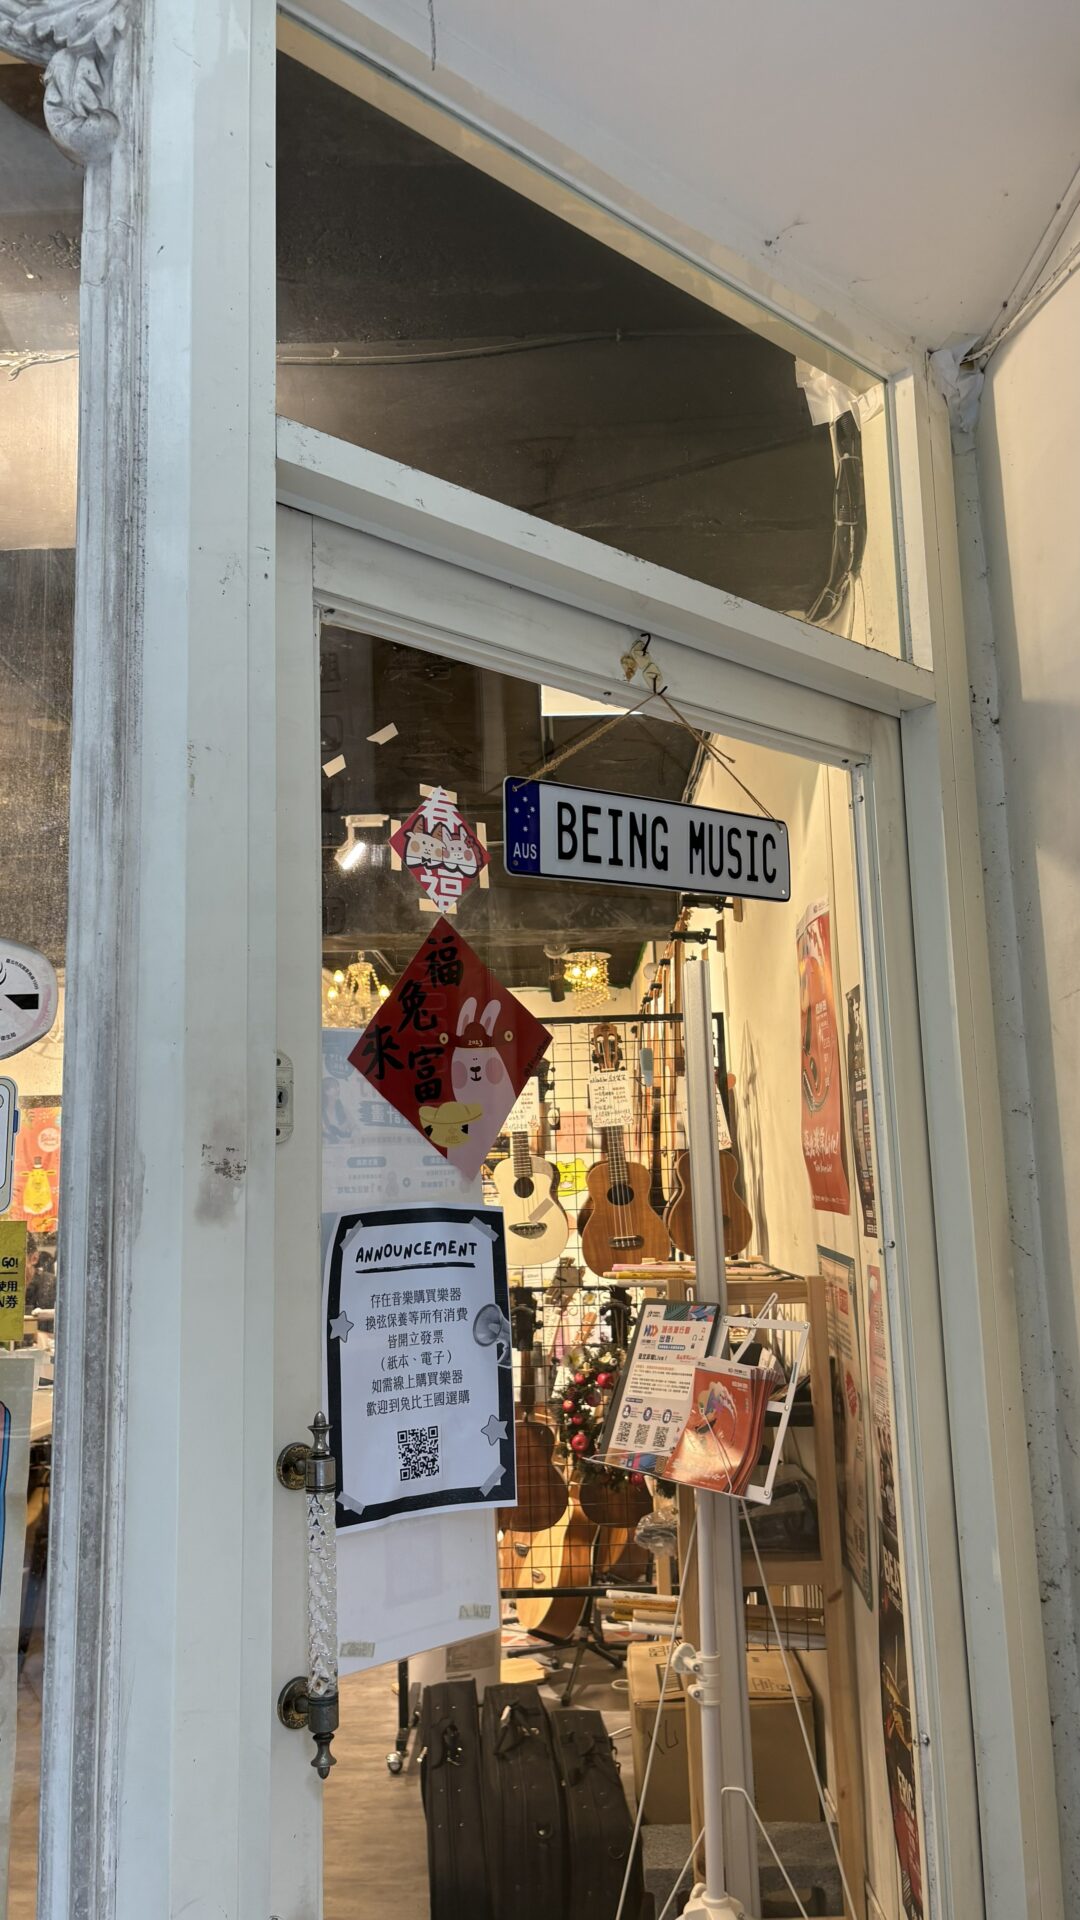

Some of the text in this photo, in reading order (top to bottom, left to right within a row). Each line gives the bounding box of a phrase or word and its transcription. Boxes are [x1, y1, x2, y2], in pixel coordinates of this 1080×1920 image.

[418, 786, 464, 832] 春
[513, 841, 537, 861] AUS
[557, 801, 777, 883] BEING MUSIC
[467, 1039, 484, 1047] 2023
[355, 1240, 478, 1263] ANNOUNCEMENT
[370, 1287, 462, 1309] 存在音樂購買樂器
[366, 1308, 469, 1331] 換弦保養等所有消費
[387, 1329, 444, 1349] 皆開立發票
[371, 1369, 464, 1394] 如需線上購買樂器
[366, 1390, 471, 1417] 歡迎到兔比王國選購
